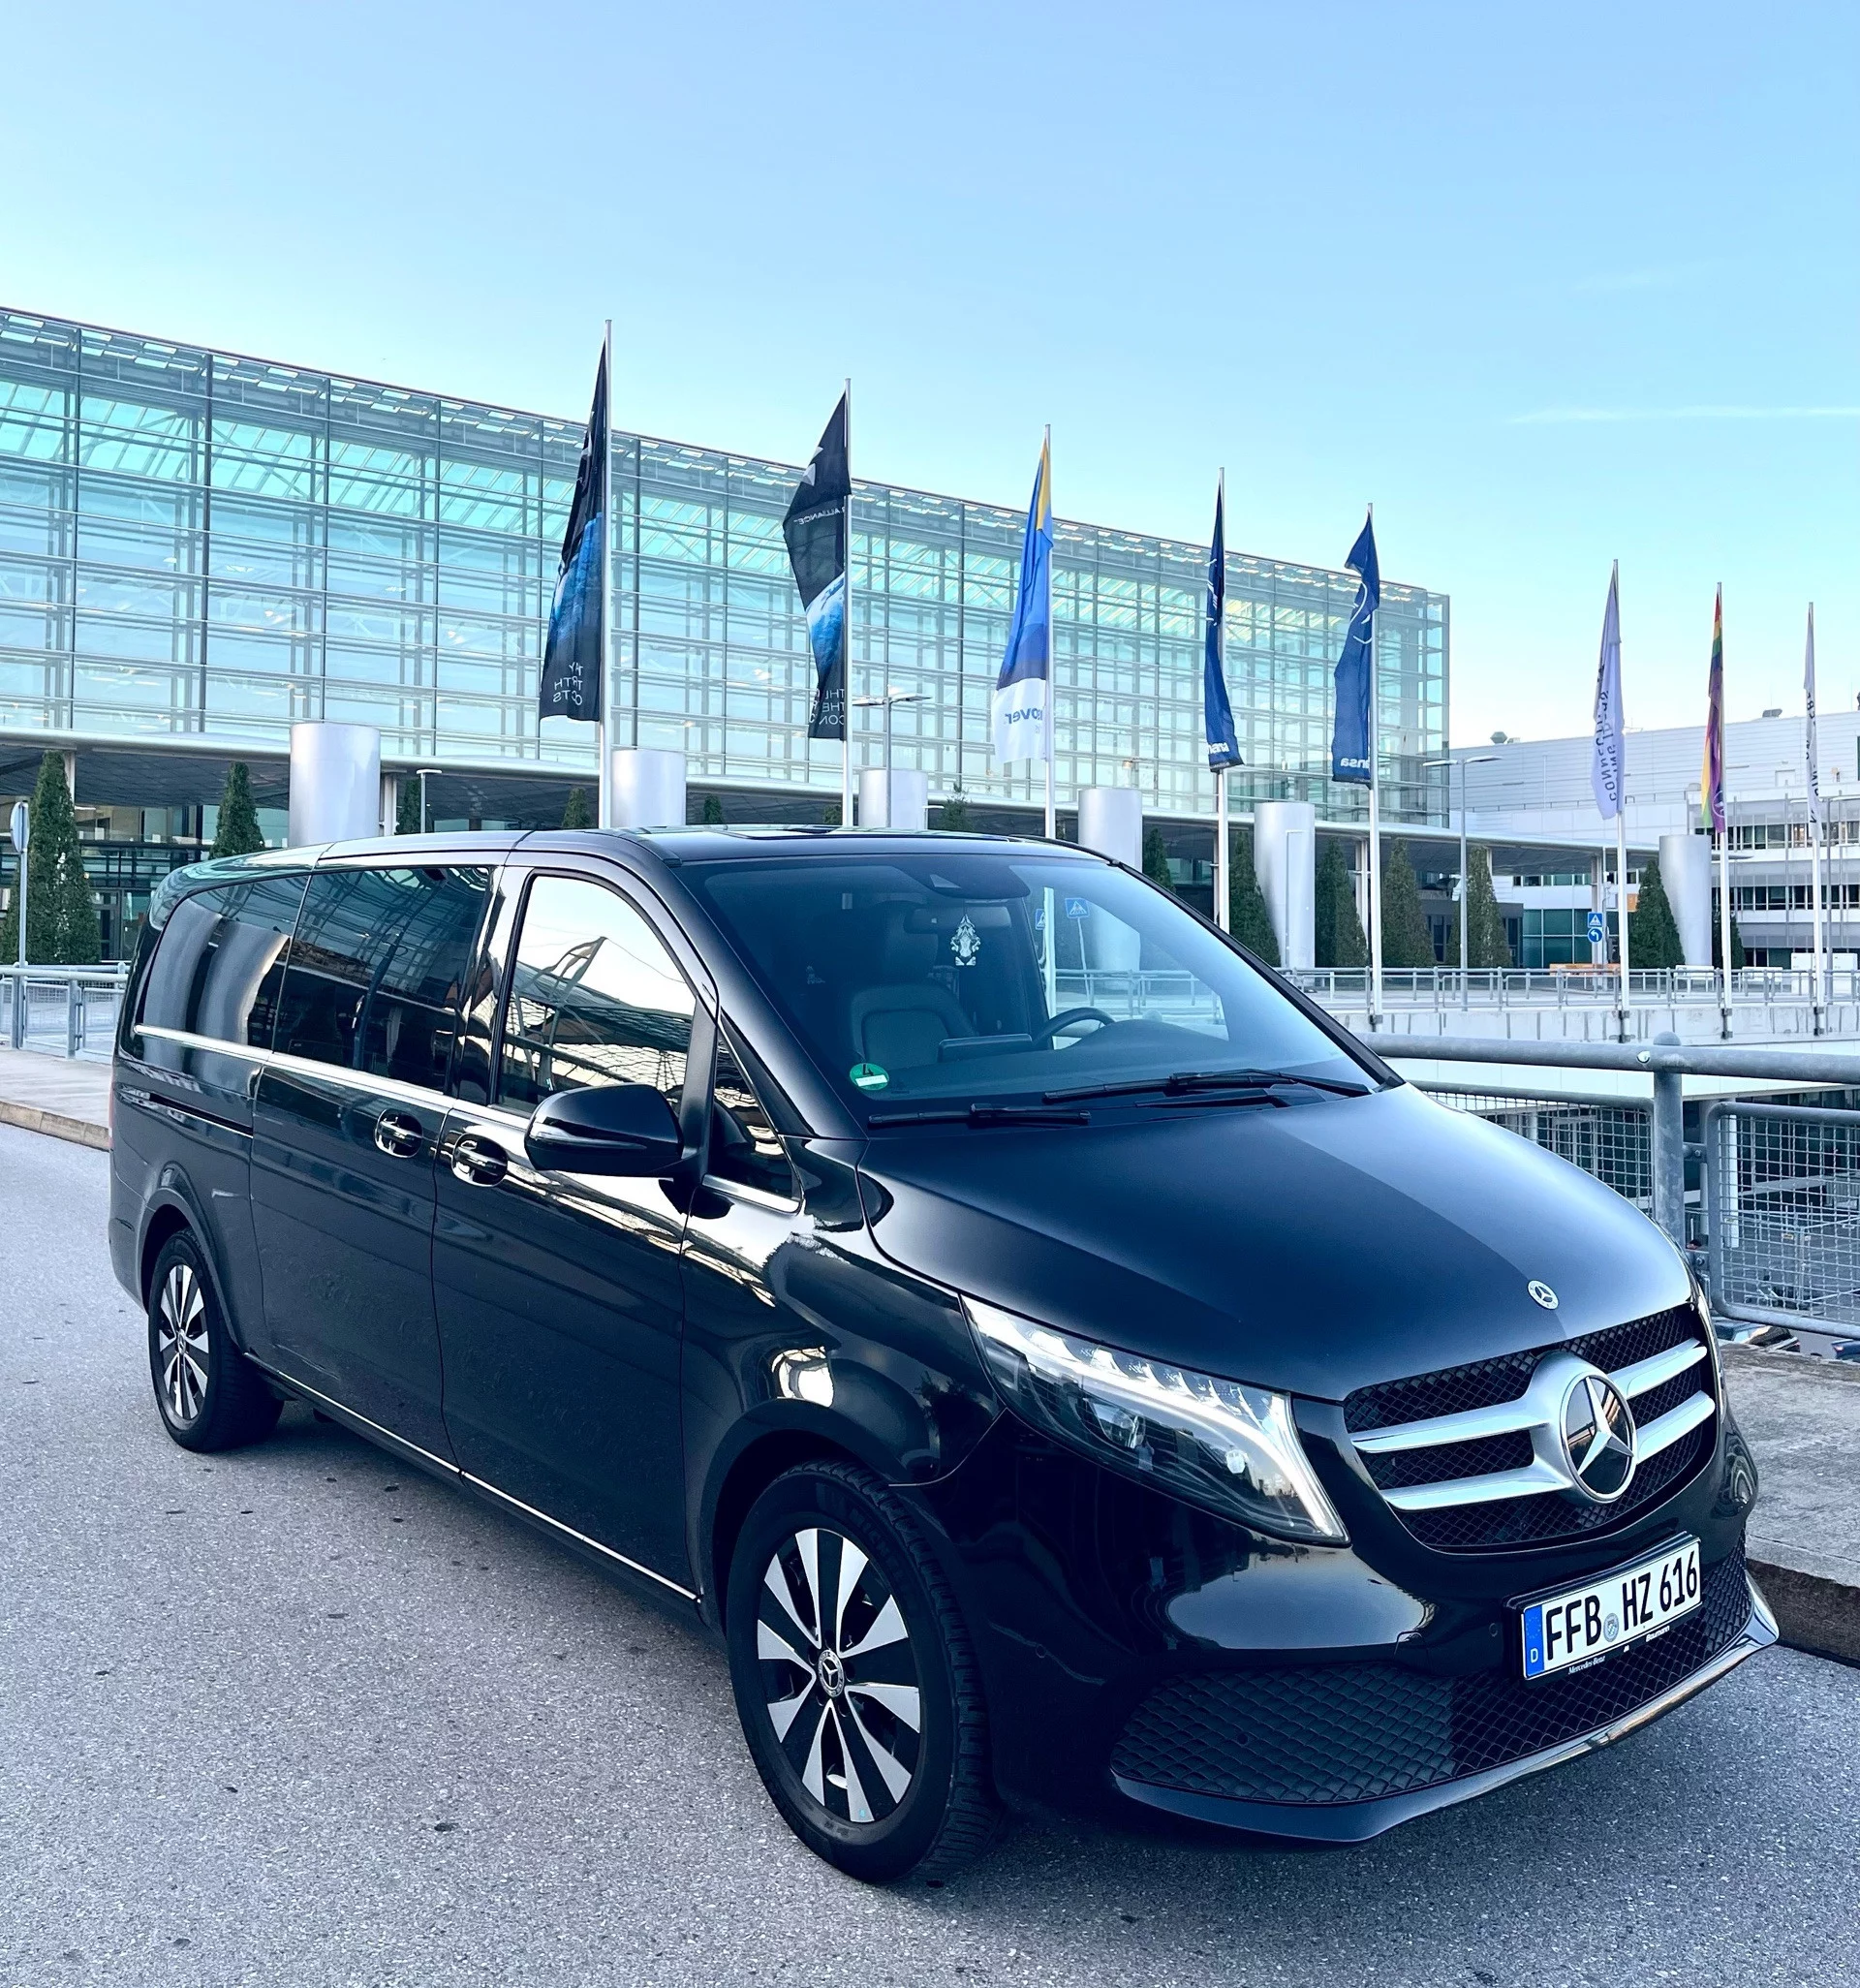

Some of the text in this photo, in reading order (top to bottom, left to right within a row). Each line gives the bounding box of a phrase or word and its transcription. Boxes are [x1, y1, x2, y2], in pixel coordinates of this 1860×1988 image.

[862, 1063, 875, 1076] 4
[1545, 1550, 1697, 1661] FFB HZ 616
[1530, 1648, 1538, 1663] D
